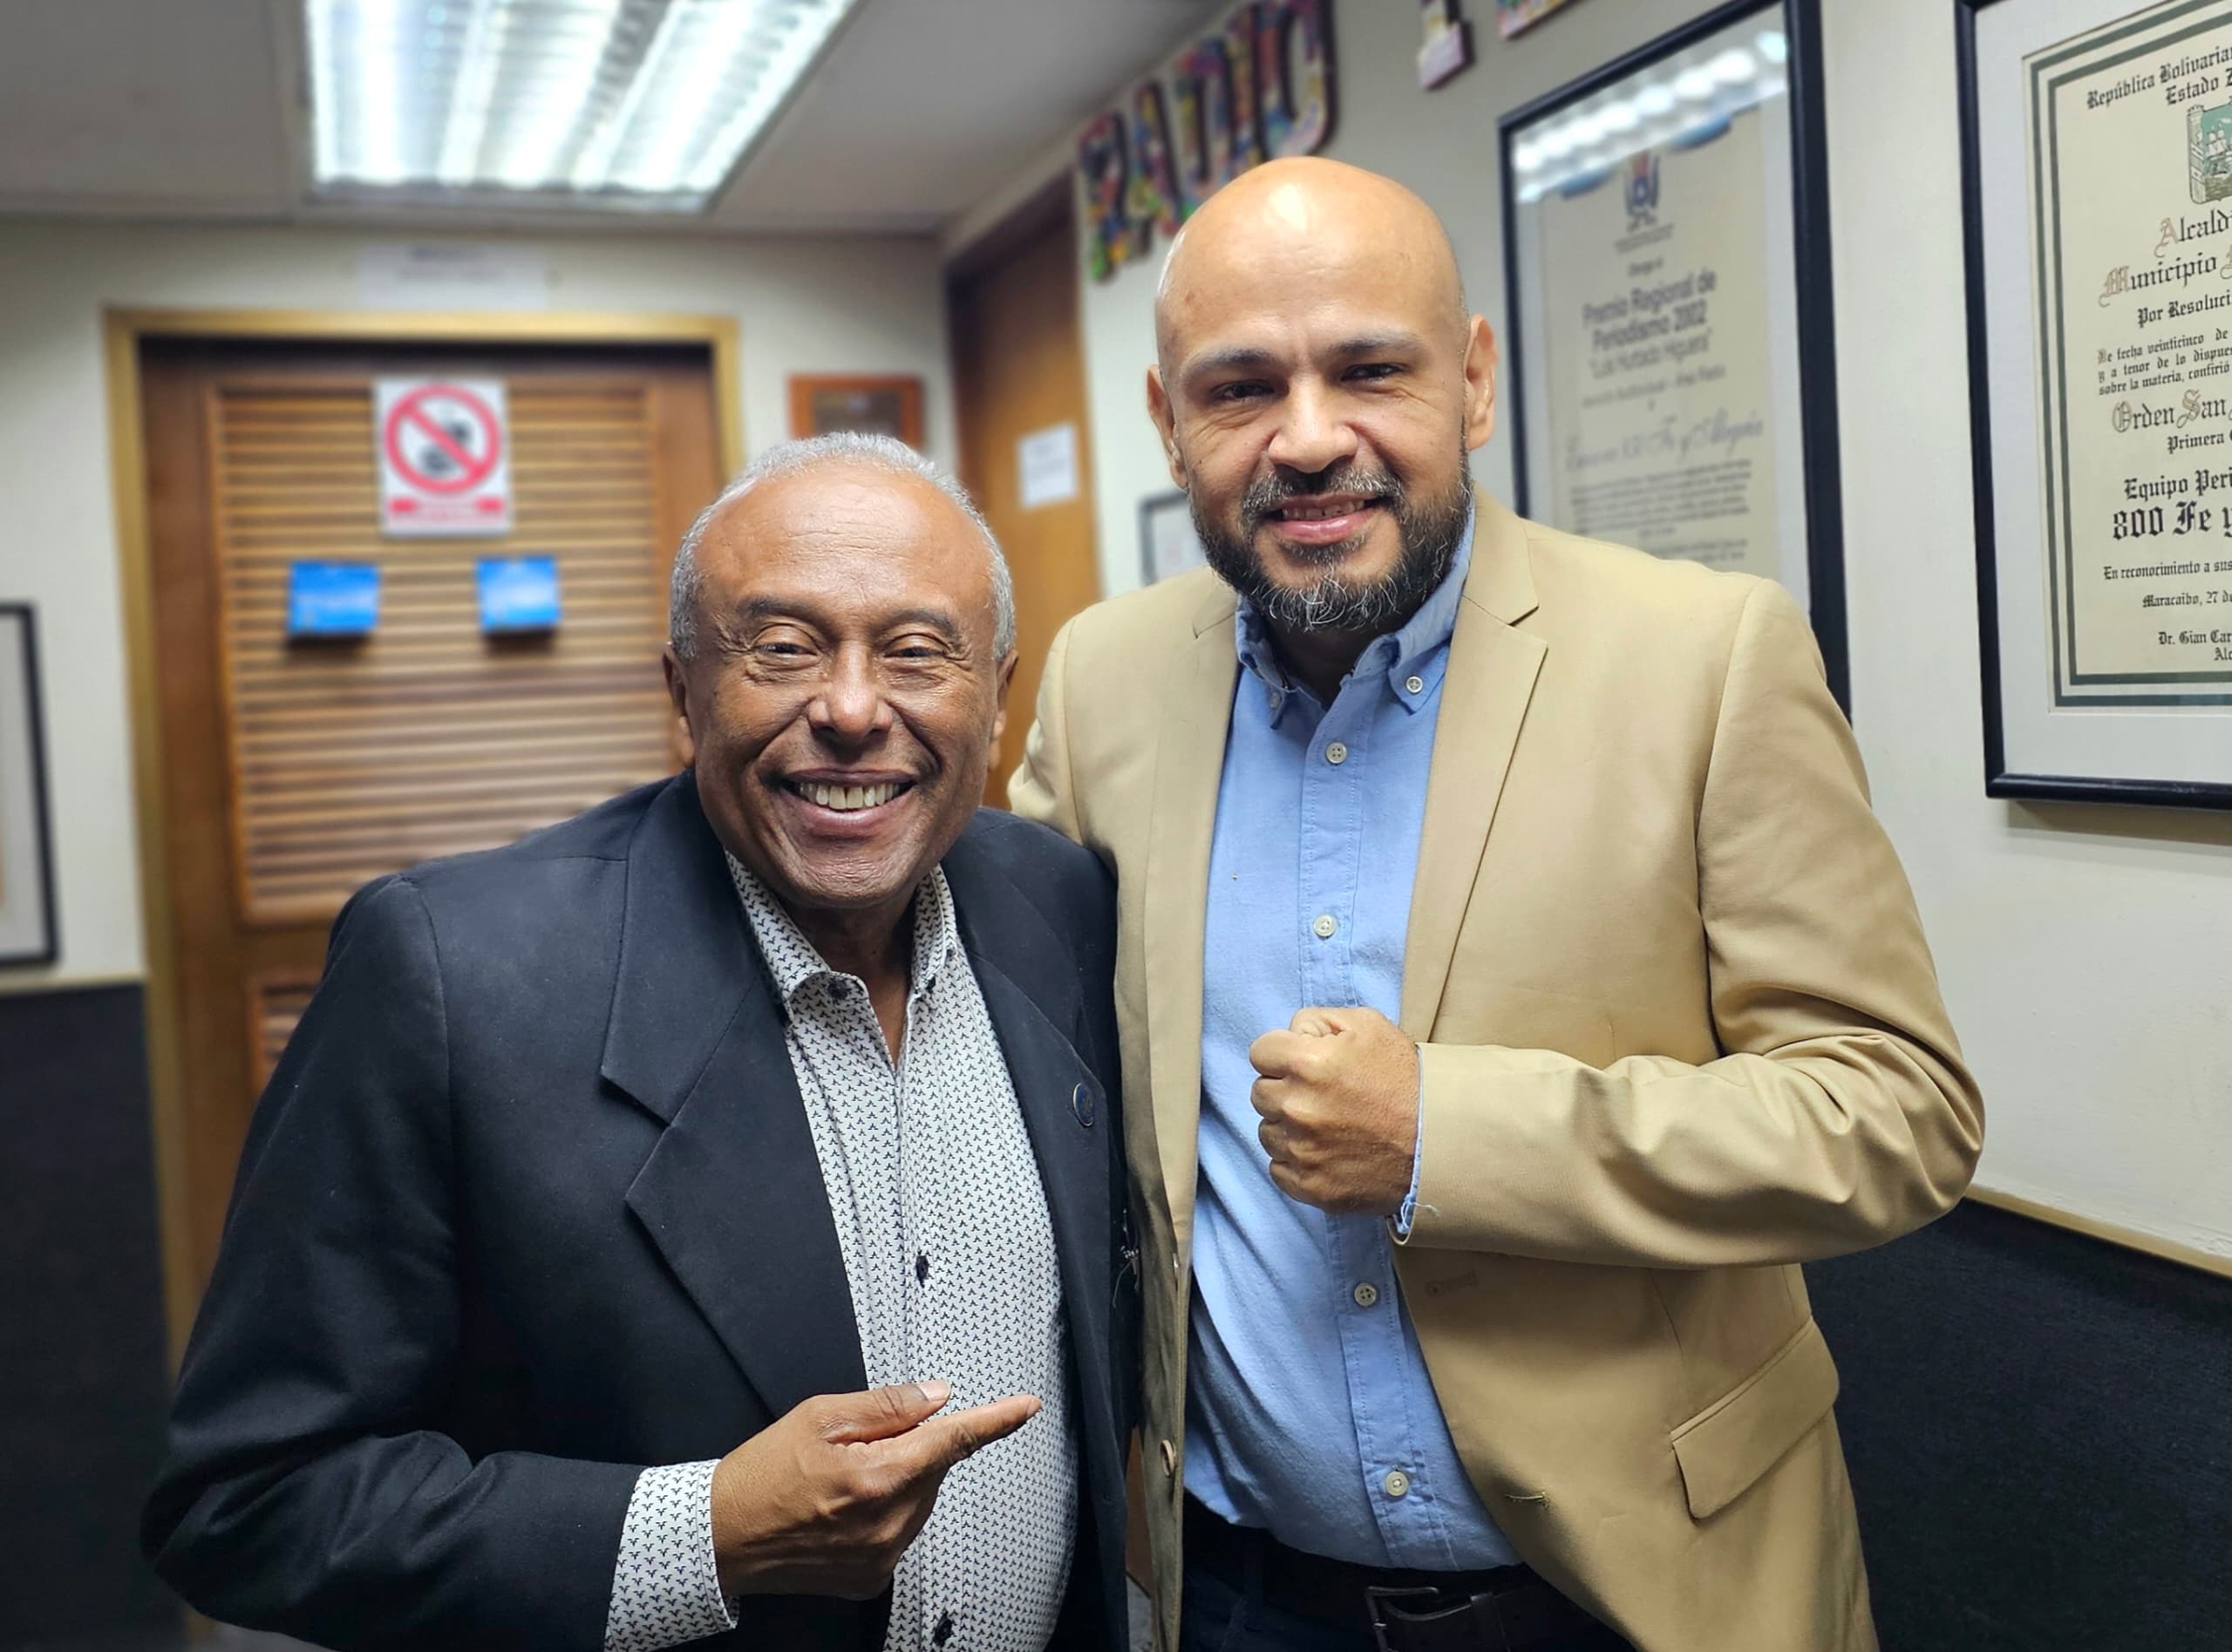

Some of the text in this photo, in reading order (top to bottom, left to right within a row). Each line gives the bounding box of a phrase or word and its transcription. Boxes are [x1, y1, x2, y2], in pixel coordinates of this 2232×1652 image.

[2086, 72, 2156, 110] República
[2165, 77, 2220, 105] Estado
[2154, 207, 2232, 258] Alcald
[2099, 251, 2217, 308] Municipio
[2137, 306, 2164, 329] Por
[2117, 345, 2143, 360] fecha
[2147, 334, 2204, 354] veinticinco
[2215, 328, 2229, 341] de
[2099, 382, 2127, 396] sobre
[2130, 378, 2139, 391] la
[2188, 360, 2230, 379] confirió
[2111, 368, 2117, 377] a
[2124, 362, 2150, 376] tenor
[2157, 357, 2169, 369] de
[2175, 353, 2187, 366] lo
[2112, 389, 2227, 433] Orden San
[2167, 433, 2225, 454] Primera
[2124, 475, 2188, 502] Equipo
[2113, 506, 2164, 540] 800
[2173, 500, 2212, 535] Fe
[2104, 566, 2119, 580] En
[2120, 561, 2201, 579] reconocimiento
[2203, 562, 2210, 573] a
[2206, 591, 2218, 603] 27
[2158, 631, 2176, 645] Dr.
[2179, 630, 2207, 644] Gian
